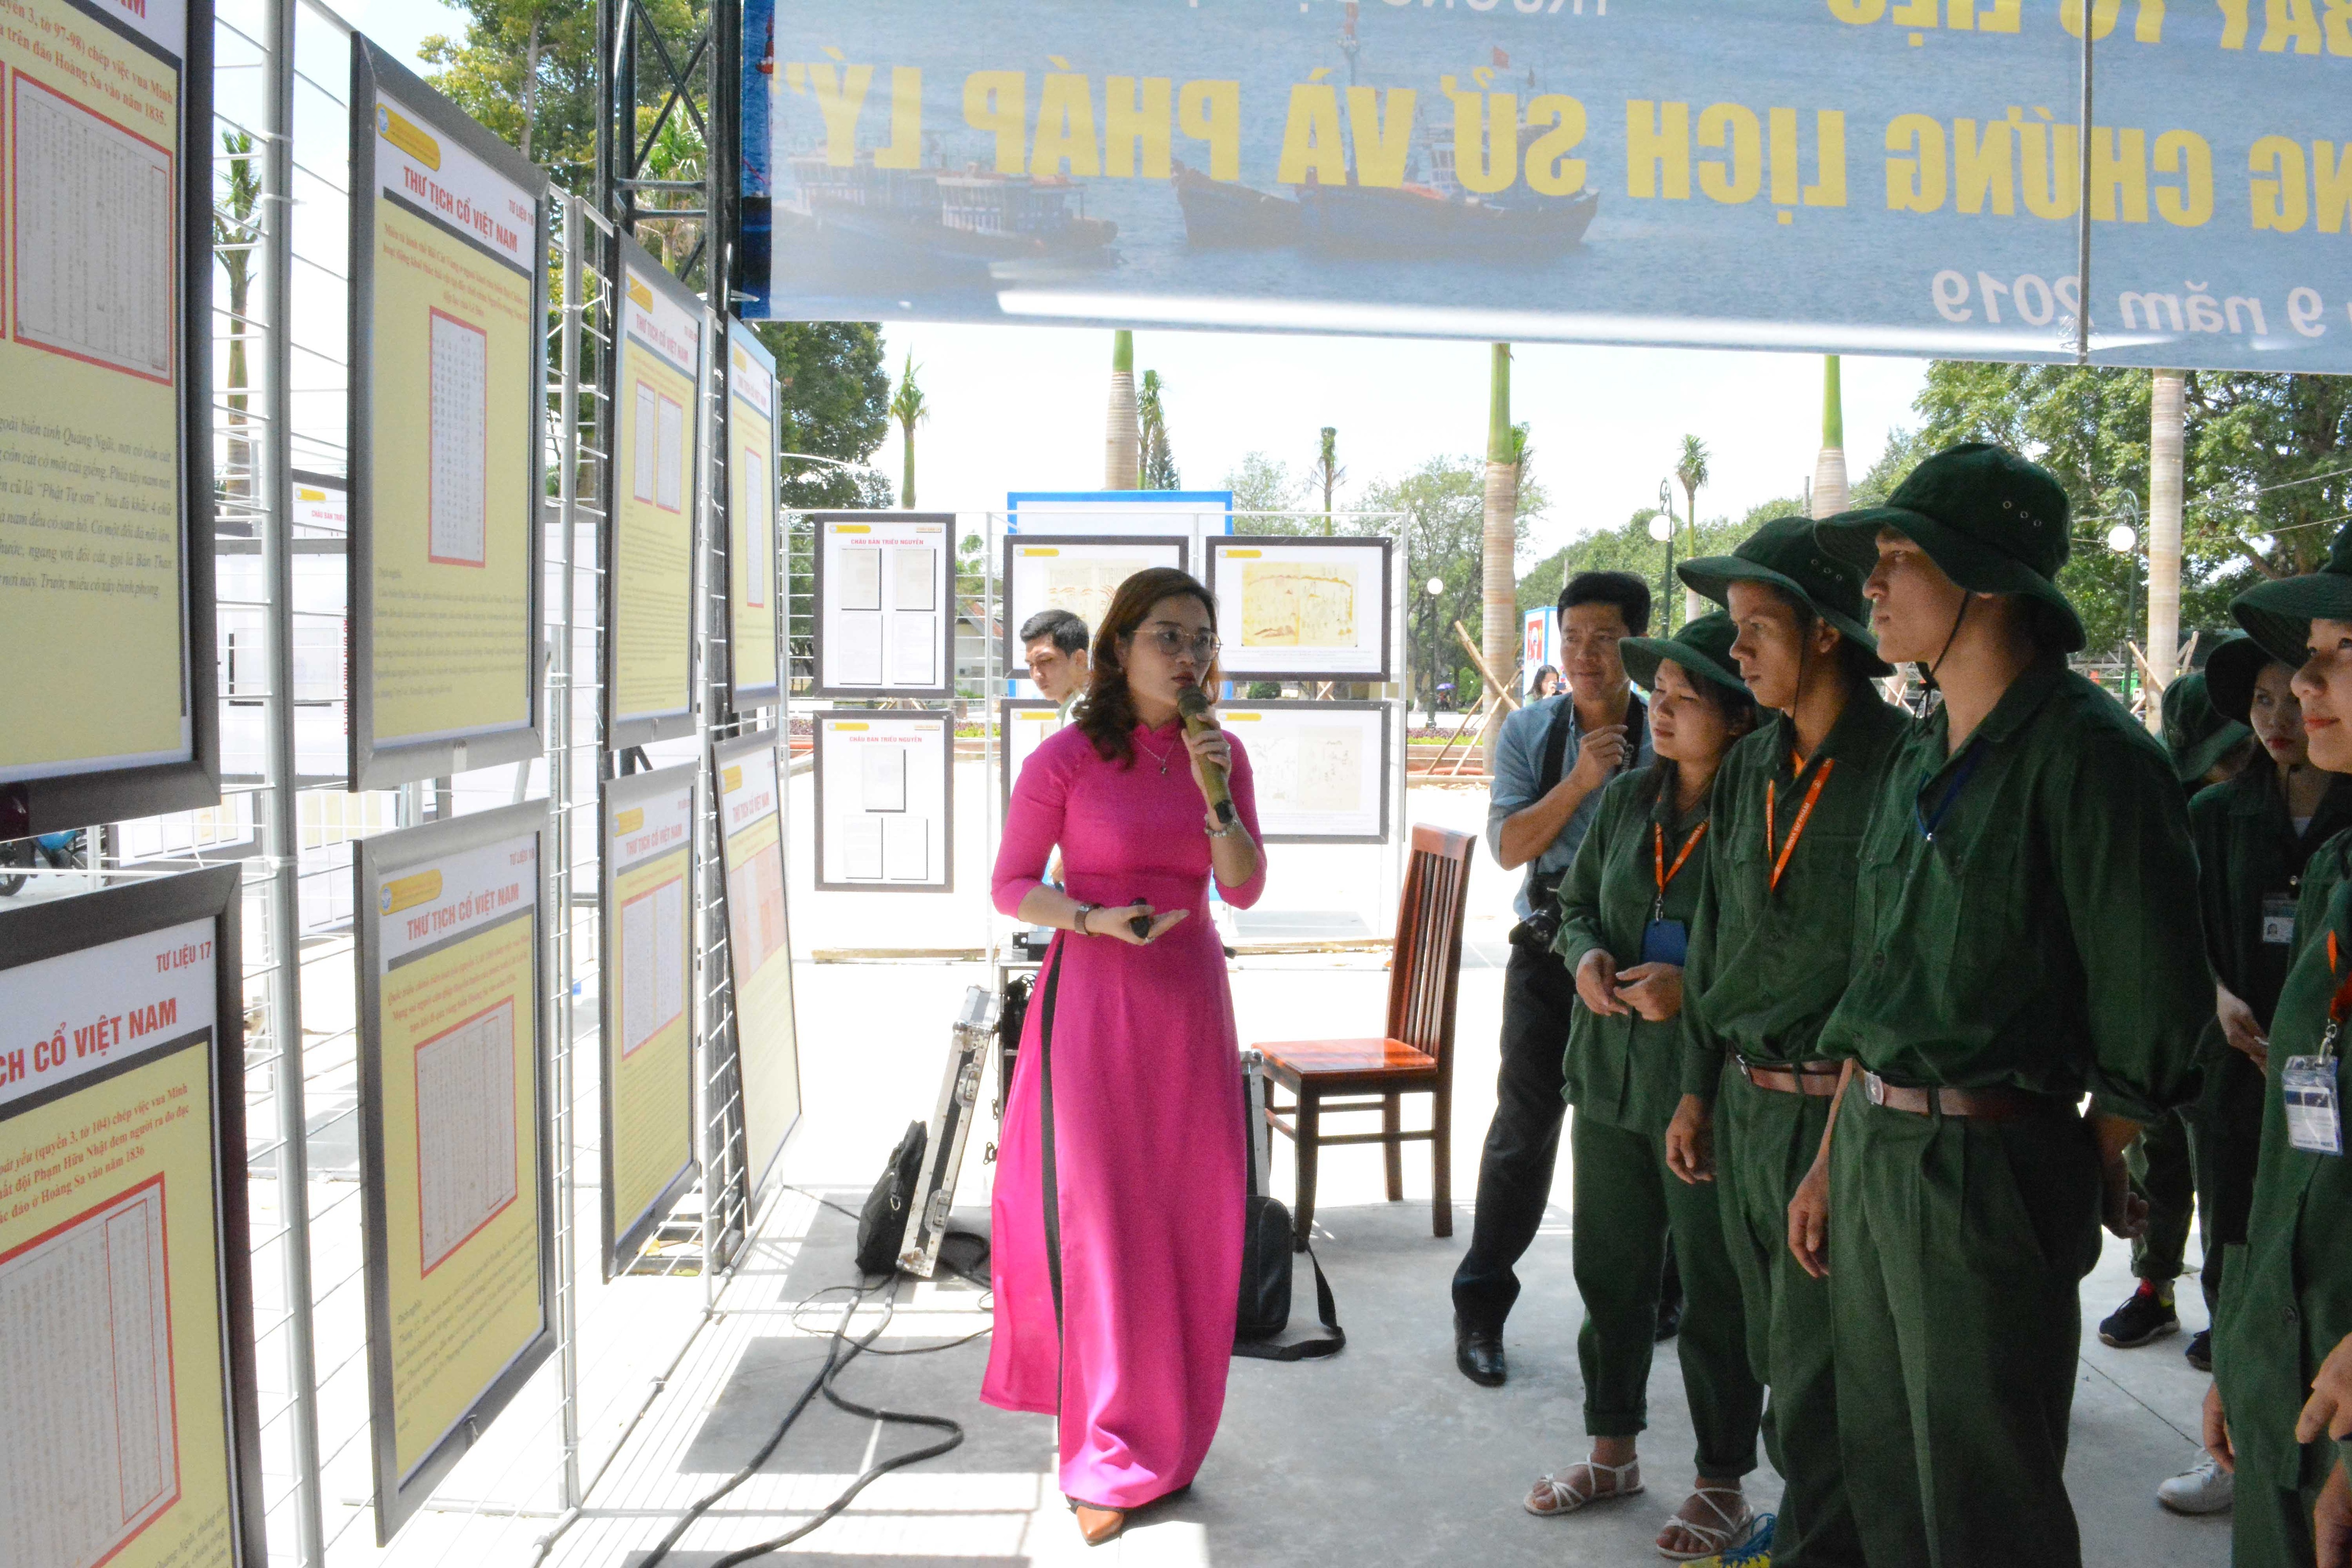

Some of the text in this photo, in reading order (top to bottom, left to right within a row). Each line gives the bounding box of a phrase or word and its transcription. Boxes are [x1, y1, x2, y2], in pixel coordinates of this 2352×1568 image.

[55, 50, 88, 87] Hoàng
[90, 71, 102, 90] Sa
[403, 166, 517, 253] THƯ TỊCH CỔ VIỆT NAM
[407, 912, 430, 940] THƯ
[432, 904, 456, 934] TỊCH
[475, 889, 496, 916] VIỆT
[497, 882, 519, 907] NAM
[156, 941, 212, 973] TƯ LIỆU 17
[33, 1022, 67, 1073] CỔ
[73, 1014, 122, 1058] VIỆT
[128, 997, 177, 1040] NAM
[16, 1147, 32, 1171] yếu
[35, 1132, 67, 1161] (quyển
[92, 1116, 110, 1133] 104)
[112, 1109, 132, 1124] chép
[134, 1100, 149, 1115] việc
[151, 1095, 165, 1106] vua
[167, 1083, 187, 1098] Minh
[16, 1173, 31, 1192] đội
[34, 1163, 61, 1183] Phạm
[64, 1153, 83, 1169] Hữu
[86, 1140, 107, 1159] Nhật
[110, 1133, 127, 1148] đem
[130, 1118, 152, 1139] người
[155, 1117, 163, 1127] ra
[165, 1110, 175, 1122] đo
[41, 1182, 72, 1203] Hoàng
[74, 1174, 85, 1187] Sa
[87, 1166, 103, 1179] vào
[105, 1157, 123, 1172] năm
